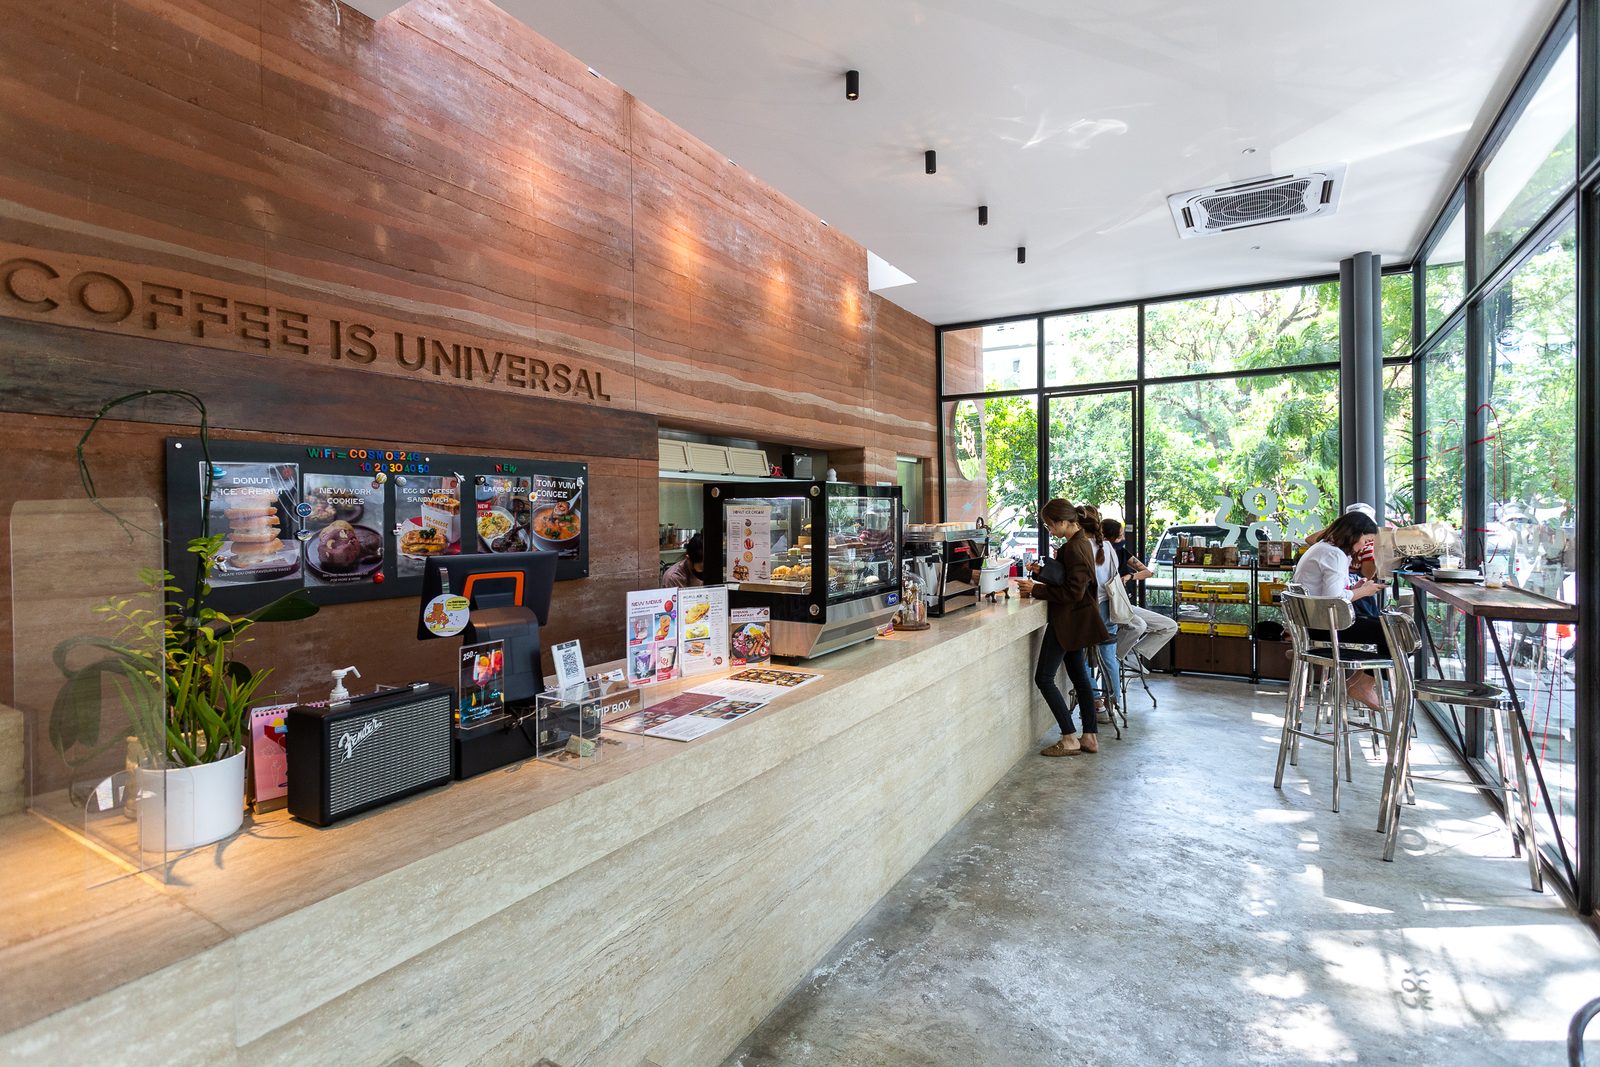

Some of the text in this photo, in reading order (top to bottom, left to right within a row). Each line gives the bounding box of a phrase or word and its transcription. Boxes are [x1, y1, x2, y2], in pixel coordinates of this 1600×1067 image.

[0, 257, 611, 402] COFFEE IS UNIVERSAL
[495, 463, 517, 474] NEW
[232, 477, 270, 485] DONUT
[536, 479, 576, 490] TOM YUM
[220, 487, 284, 496] ICE CREAM
[319, 487, 347, 495] NEW
[536, 489, 568, 499] CONGEE
[594, 699, 631, 719] TIP BOX
[338, 718, 383, 760] Fender
